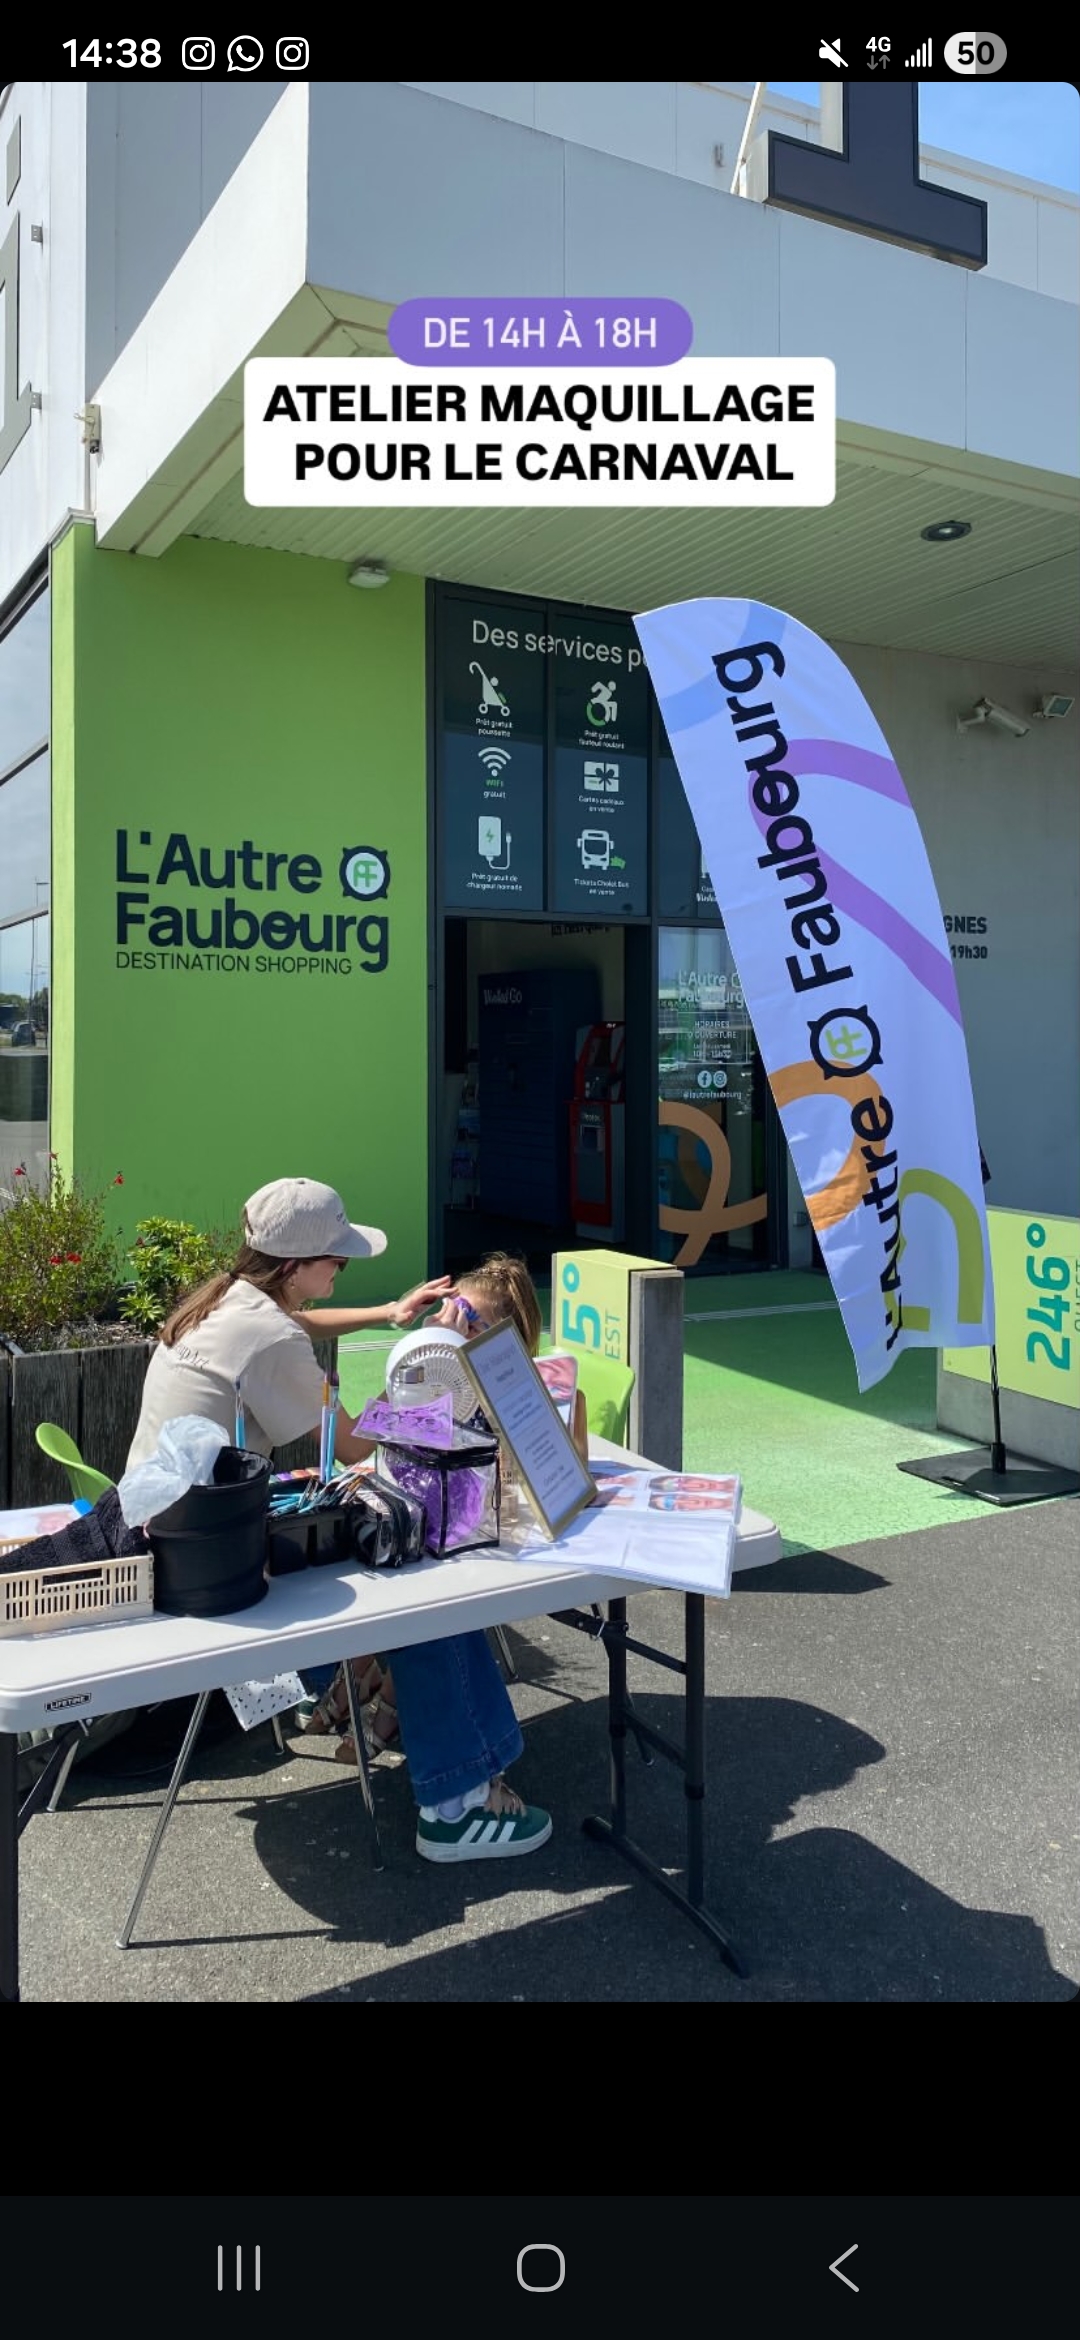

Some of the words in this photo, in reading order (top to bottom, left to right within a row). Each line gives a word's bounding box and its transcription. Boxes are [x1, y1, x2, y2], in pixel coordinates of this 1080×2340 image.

[472, 619, 519, 649] Des
[524, 633, 623, 665] services
[628, 648, 647, 673] p
[711, 640, 854, 995] Faubourg
[117, 829, 322, 893] L'Autre
[117, 891, 389, 974] Faubourg
[950, 944, 988, 959] 19h30
[116, 950, 250, 972] DESTINATION
[255, 955, 352, 976] SHOPPING
[1026, 1222, 1071, 1371] 246°
[604, 1309, 621, 1360] EST
